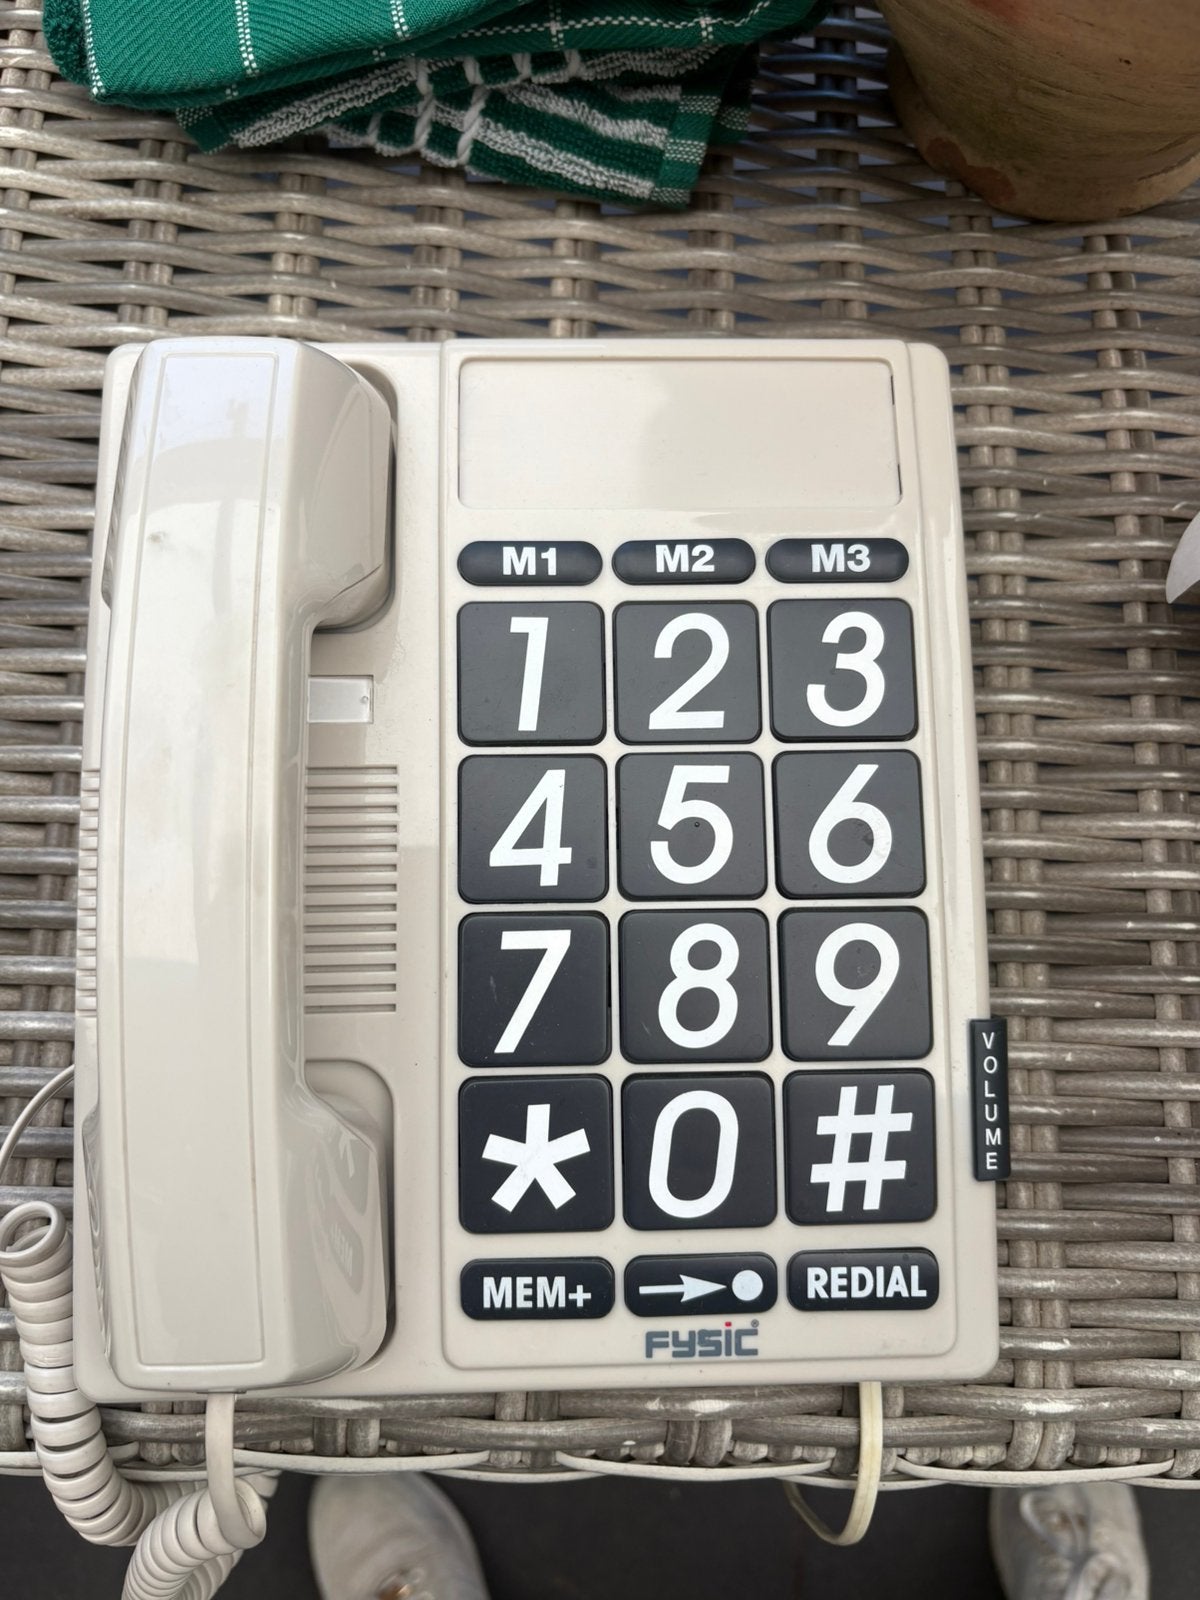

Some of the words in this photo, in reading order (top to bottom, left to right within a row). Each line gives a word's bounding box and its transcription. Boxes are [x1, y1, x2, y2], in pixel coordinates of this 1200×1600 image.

[503, 547, 557, 576] M1
[656, 544, 716, 573] M2
[811, 544, 872, 573] M3
[510, 616, 549, 731] 1
[648, 612, 729, 730] 2
[806, 611, 885, 727] 3
[489, 769, 572, 886] 4
[650, 765, 733, 884] 5
[809, 764, 892, 883] 6
[494, 930, 571, 1053] 7
[658, 923, 739, 1048] 8
[815, 923, 900, 1046] 9
[649, 1090, 738, 1218] 0
[810, 1084, 913, 1212] #
[981, 1031, 1002, 1170] VOLUME
[483, 1276, 592, 1309] MEM+
[808, 1265, 927, 1299] REDIAL
